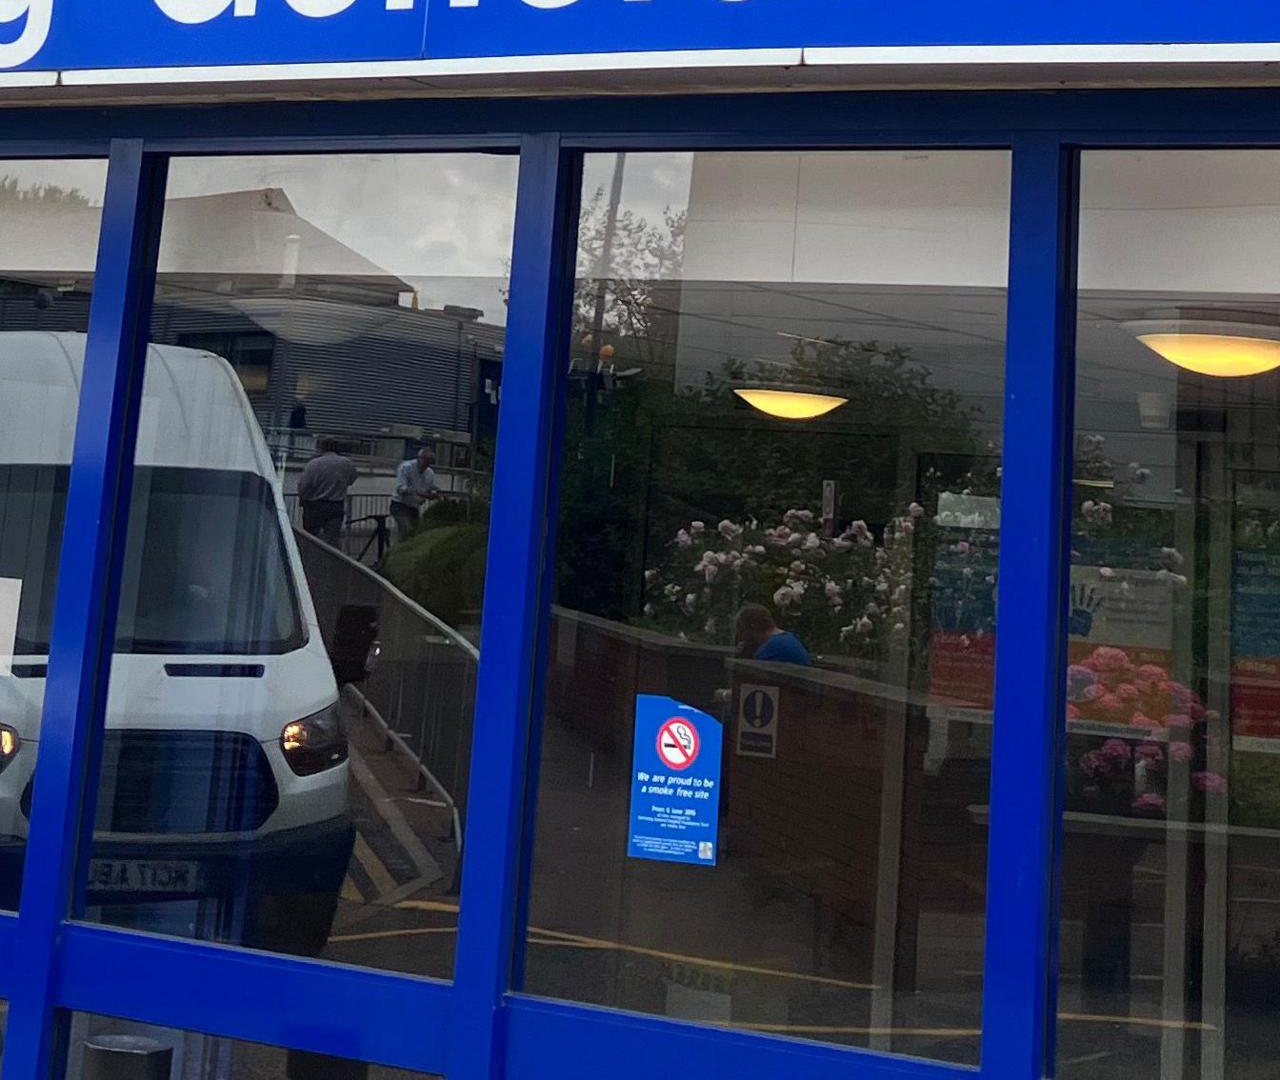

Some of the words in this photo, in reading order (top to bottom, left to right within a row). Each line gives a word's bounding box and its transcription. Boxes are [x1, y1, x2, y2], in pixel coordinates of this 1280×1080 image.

[637, 771, 650, 782] We
[651, 775, 666, 783] are
[667, 775, 693, 787] proud
[693, 778, 703, 787] to
[703, 778, 714, 789] be
[648, 786, 674, 796] smoke
[676, 787, 694, 798] free
[694, 790, 710, 800] site
